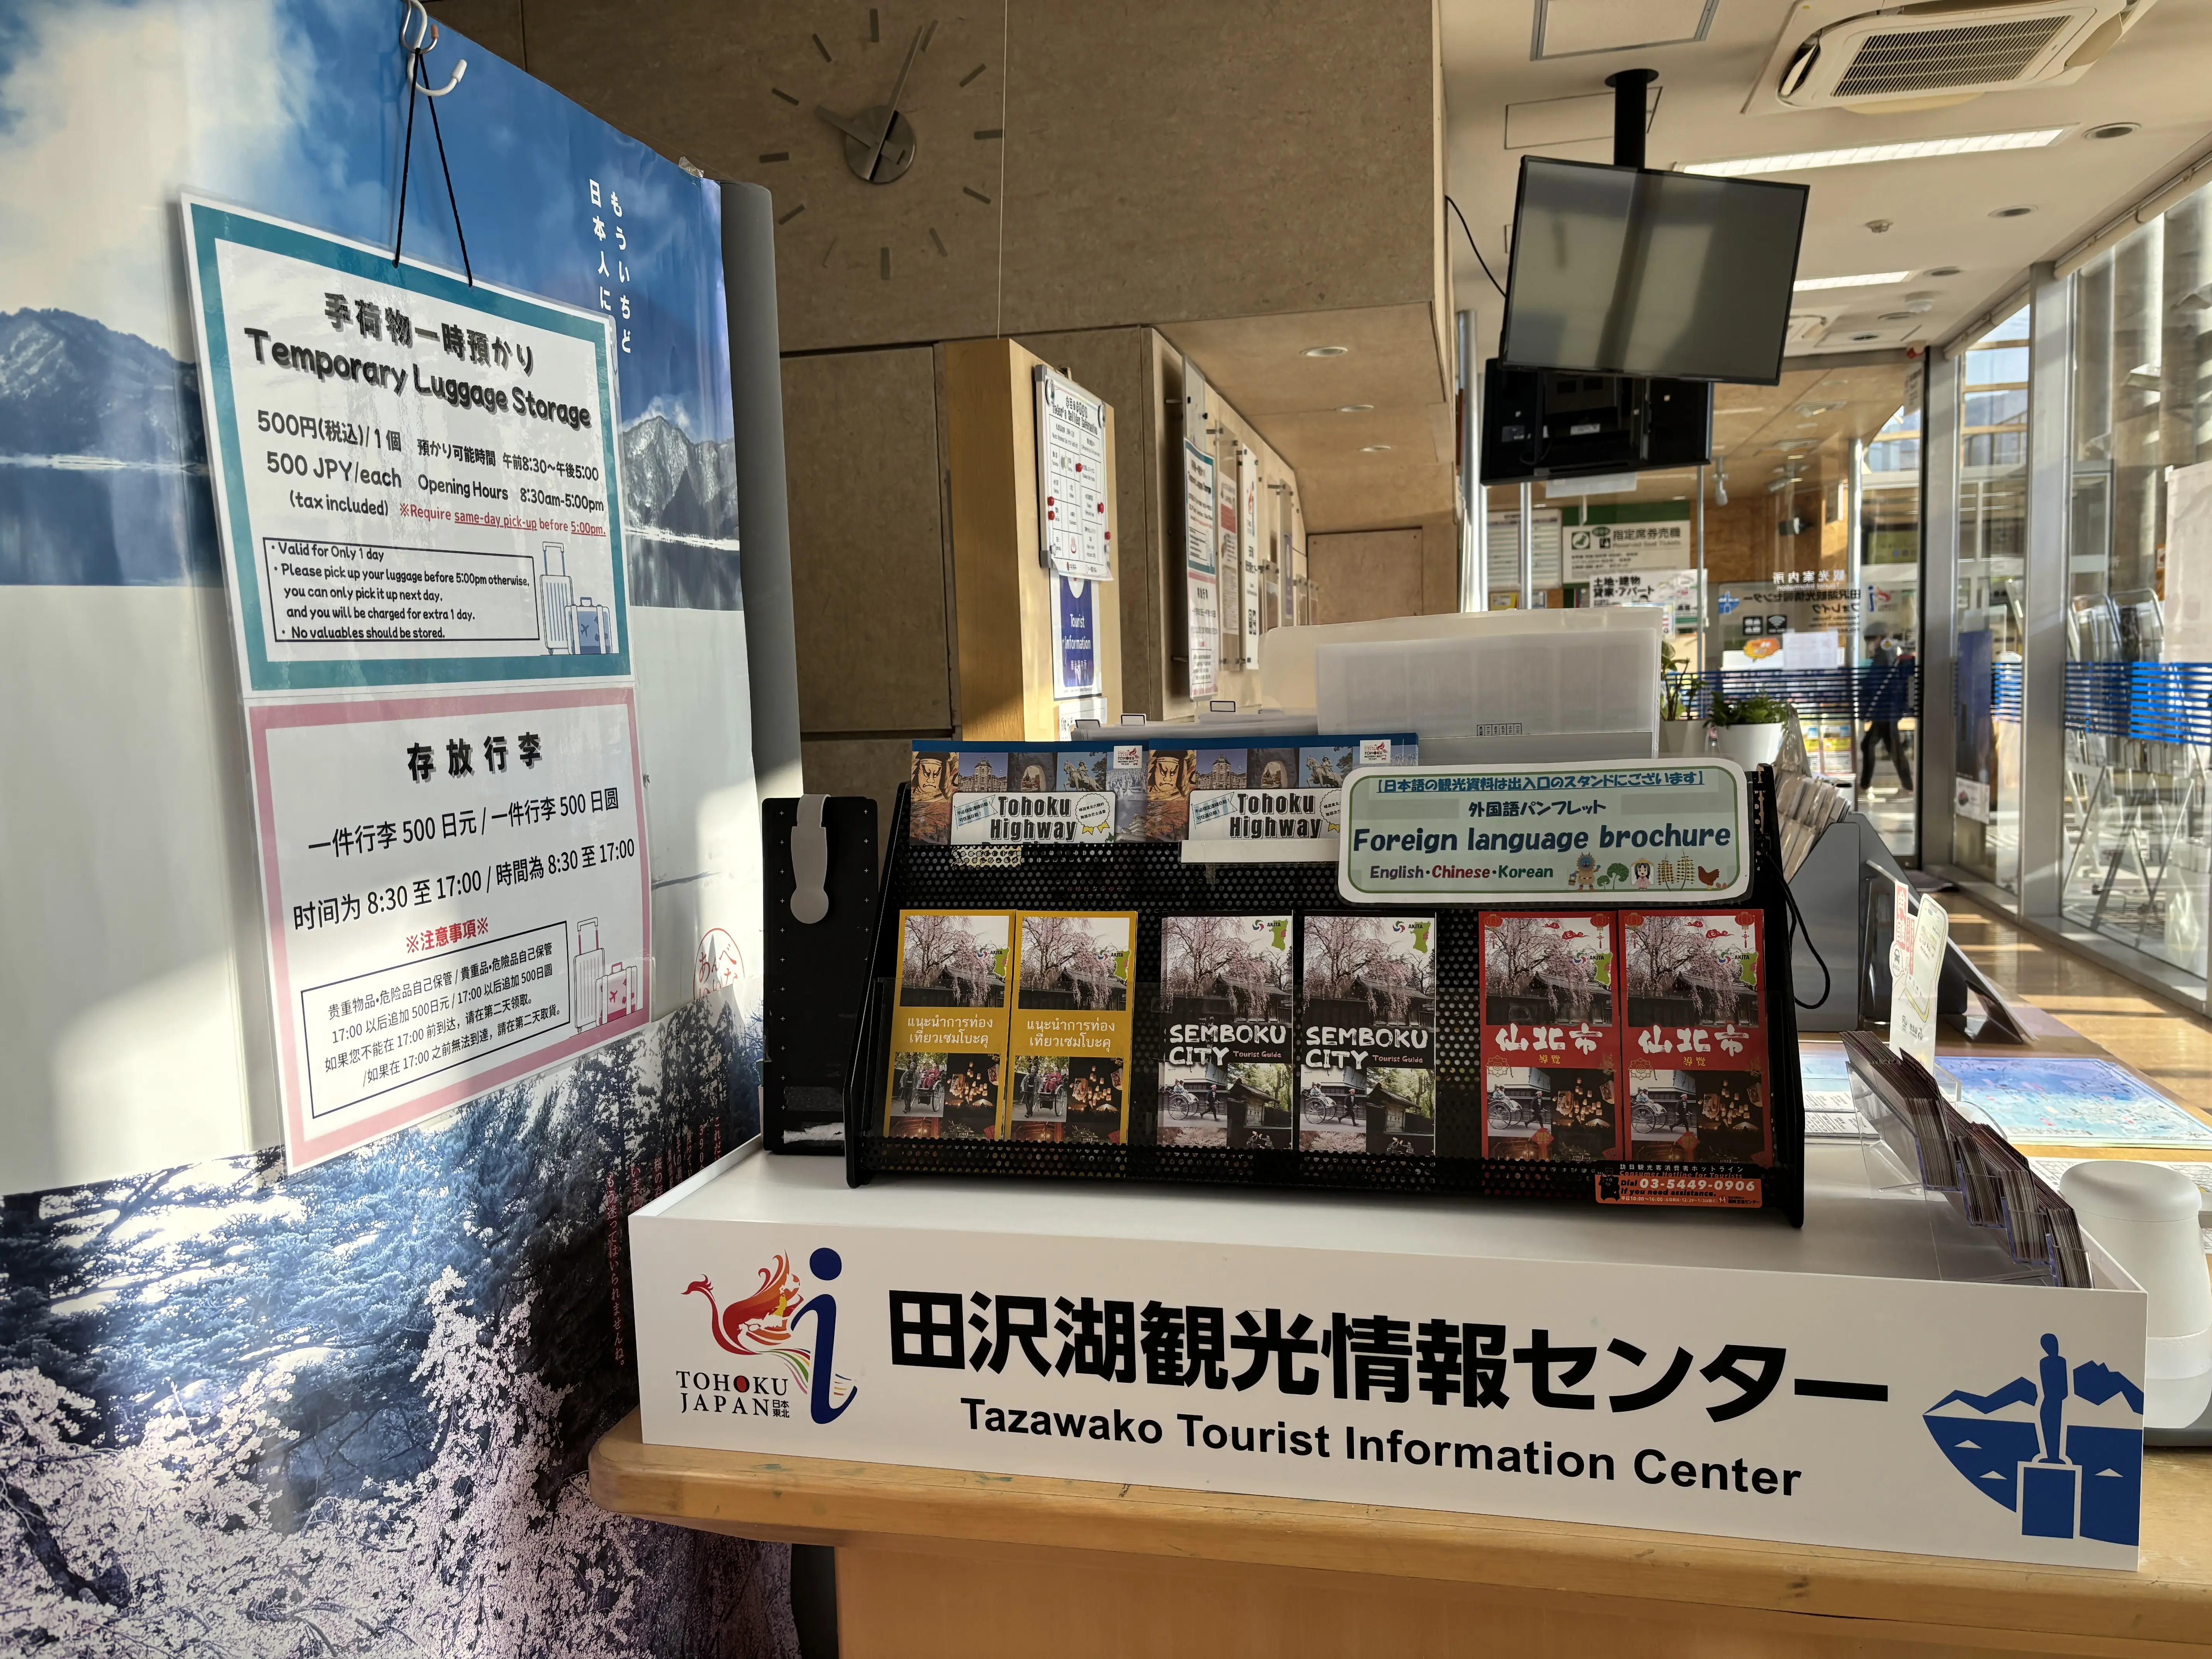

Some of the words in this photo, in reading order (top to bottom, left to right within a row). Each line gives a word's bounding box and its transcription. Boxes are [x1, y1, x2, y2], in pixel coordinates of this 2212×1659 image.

[589, 179, 611, 311] 日本人に
[611, 191, 631, 353] もういちど
[324, 292, 534, 375] 手荷物一時預かり
[244, 327, 407, 396] Temporary
[414, 363, 508, 414] Luggage
[512, 386, 592, 430] Storage
[417, 438, 496, 467] 預かり可能時間
[267, 450, 309, 476] 500
[314, 455, 402, 489] JPY/each
[418, 474, 470, 500] Opening
[473, 479, 508, 501] Hours
[520, 487, 604, 512] 8:30am-5:00pm
[290, 489, 323, 511] (tax
[326, 494, 388, 517] included)
[454, 510, 503, 529] same-day
[503, 514, 537, 531] pick-up
[539, 516, 568, 533] before
[570, 520, 606, 537] 5:00pm.
[278, 541, 309, 556] Valid
[311, 544, 329, 557] for
[331, 545, 356, 561] Only
[359, 547, 363, 559] 1
[366, 548, 384, 563] day
[281, 563, 322, 577] Please
[324, 565, 346, 580] pick
[348, 569, 360, 581] up
[362, 570, 384, 581] your
[386, 568, 422, 583] luggage
[424, 570, 454, 583] before
[456, 572, 487, 586] 5:00pm
[488, 574, 529, 587] otherwise,
[283, 587, 306, 599] you
[307, 587, 328, 598] can
[330, 586, 353, 601] only
[356, 587, 376, 601] pick
[376, 587, 385, 599] it
[386, 591, 398, 602] up
[399, 589, 422, 600] next
[286, 605, 308, 618] and
[309, 609, 330, 620] you
[332, 606, 352, 618] will
[354, 606, 366, 618] be
[368, 607, 405, 621] charged
[407, 607, 421, 620] for
[422, 608, 448, 620] extra
[450, 608, 454, 620] 1
[457, 608, 475, 622] day.
[1070, 613, 1085, 628] Tourist
[291, 626, 308, 638] No
[310, 626, 364, 639] valuables
[366, 626, 398, 638] should
[400, 627, 411, 638] be
[413, 627, 445, 638] stored.
[1065, 635, 1091, 650] Information
[407, 731, 544, 783] 存放行李
[998, 796, 1072, 817] Tohoku
[1237, 792, 1316, 815] Tohoku
[1468, 799, 1607, 817] 外国語パンフレット
[308, 821, 397, 859] 一件行李
[402, 816, 436, 844] 500
[442, 809, 477, 839] 日元
[491, 795, 557, 828] 一件行李
[560, 792, 586, 817] 500
[990, 818, 1077, 842] Highway
[1230, 816, 1323, 839] Highway
[1353, 827, 1458, 854] Foreign
[1468, 826, 1589, 854] language
[1599, 822, 1731, 848] brochure
[294, 892, 361, 931] 时间为
[368, 885, 409, 915] 8:30
[412, 878, 433, 908] 至
[436, 869, 482, 901] 17:00
[496, 856, 545, 887] 時間為
[548, 849, 579, 876] 8:30
[581, 845, 598, 869] 至
[599, 838, 635, 864] 17:00
[332, 1022, 363, 1044] 17:00
[457, 987, 482, 1005] 17:00
[1169, 1024, 1286, 1044] SEMBOKU
[1306, 1026, 1429, 1048] SEMBOKU
[1495, 1023, 1602, 1055] 仙北市
[1638, 1024, 1749, 1056] 仙北市
[324, 1039, 395, 1072] 如果您不能在
[397, 1028, 424, 1047] 17:00
[403, 1049, 429, 1070] 17:00
[1169, 1046, 1230, 1066] CITY
[1233, 1050, 1259, 1058] Tourist
[1305, 1049, 1369, 1070] CITY
[1372, 1054, 1400, 1063] Tourist
[1639, 1178, 1755, 1192] 03-5449-0906
[606, 1175, 624, 1365] もう迷ってはいられませんね。
[889, 1290, 1888, 1422] 田沢湖観光情報センター
[676, 1370, 788, 1396] TOHOKU
[681, 1392, 769, 1417] JAPAN
[961, 1398, 1162, 1443] Tazawako
[1177, 1414, 1329, 1457] Tourist
[1347, 1427, 1614, 1480] Information
[1635, 1449, 1802, 1496] Center
